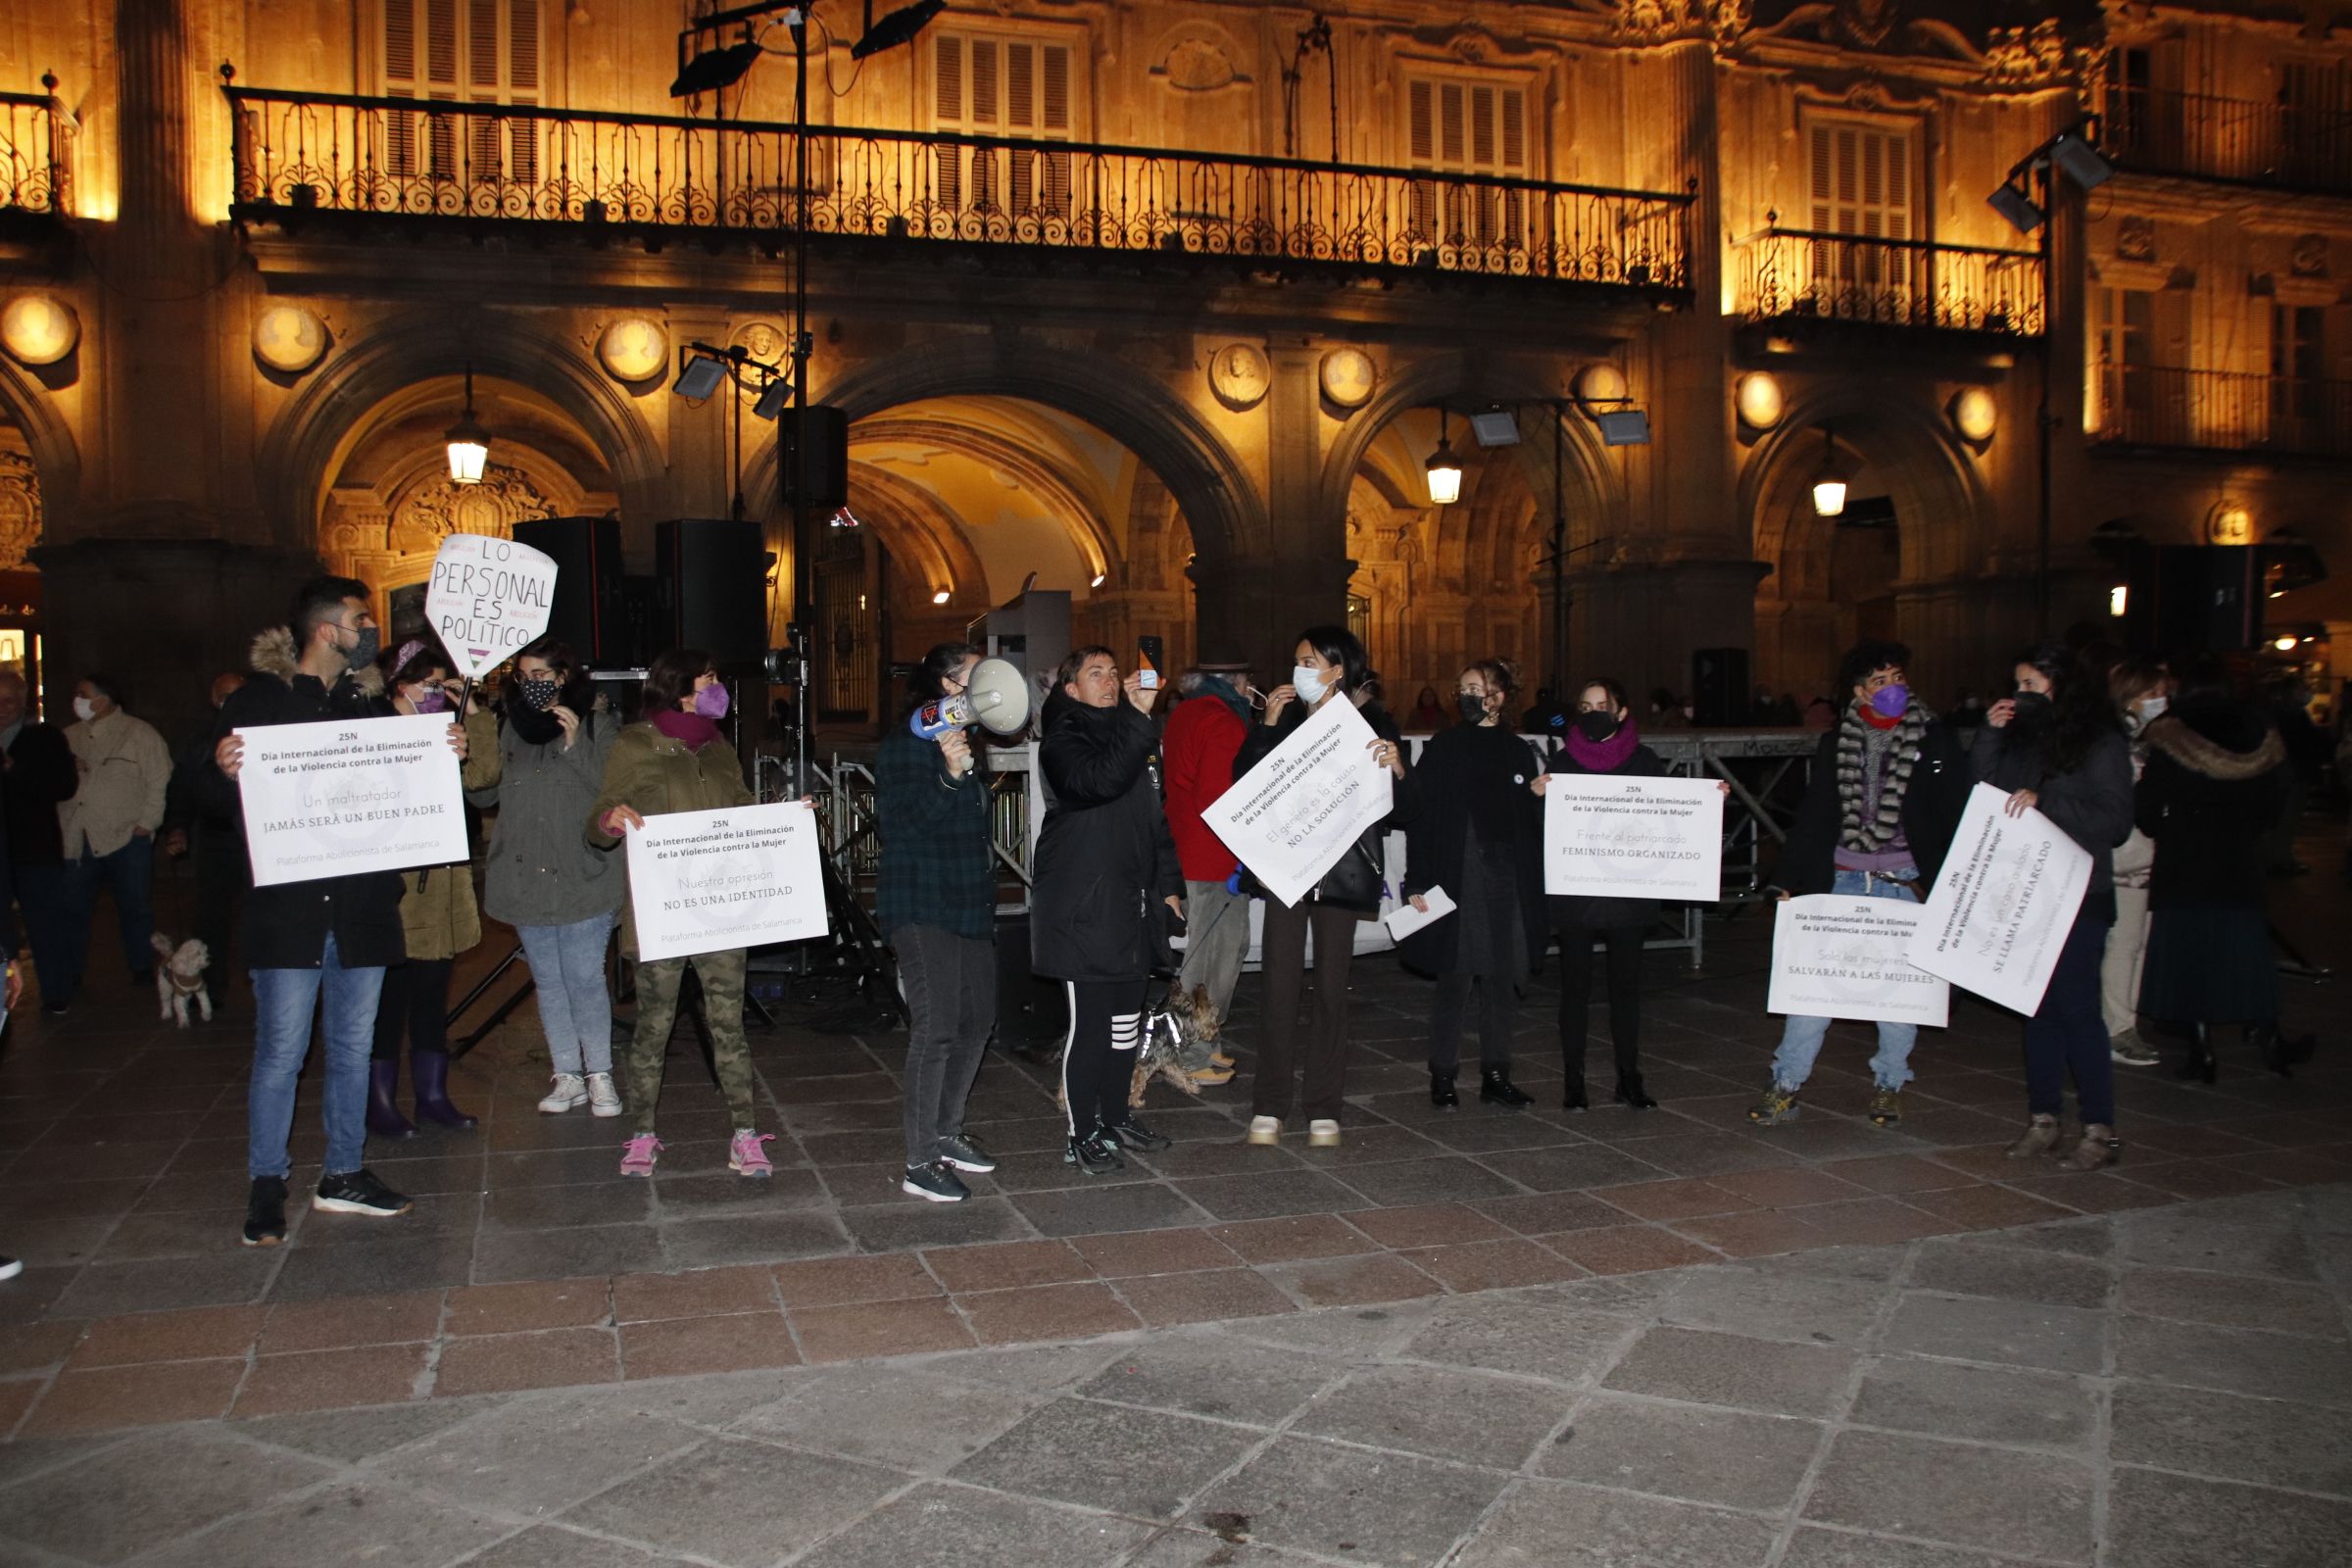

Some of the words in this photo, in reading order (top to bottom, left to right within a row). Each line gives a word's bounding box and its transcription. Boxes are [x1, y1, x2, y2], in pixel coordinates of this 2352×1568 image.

[482, 540, 511, 562] LO
[433, 561, 549, 608] PERSONAL
[473, 598, 503, 620] ES
[441, 614, 529, 647] POLÍTICO
[281, 746, 349, 760] Internacional
[377, 740, 431, 751] Eliminación
[301, 760, 346, 771] Violencia
[349, 759, 381, 767] contra
[395, 754, 422, 763] Mujer
[1243, 771, 1286, 811] Internacional
[1286, 764, 1295, 773] de
[1301, 724, 1341, 759] Eliminación
[1271, 758, 1285, 771] 25N
[1246, 816, 1254, 825] de
[1260, 783, 1291, 810] Violencia
[1292, 763, 1313, 784] contra
[1320, 738, 1340, 758] Mujer
[303, 795, 322, 809] Un
[326, 787, 402, 807] maltratador
[264, 818, 305, 833] JAMÁS
[309, 813, 340, 827] SERÁ
[345, 812, 363, 823] UN
[368, 808, 400, 820] BUEN
[405, 805, 444, 816] PADRE
[1287, 835, 1301, 848] NO
[1301, 824, 1315, 835] LA
[1314, 781, 1359, 824] SOLUCIÓN
[663, 833, 721, 846] Internacional
[746, 826, 794, 837] Eliminación
[680, 846, 720, 857] Violencia
[761, 839, 786, 848] Mujer
[1563, 848, 1624, 857] FEMINISMO
[1628, 850, 1700, 859] ORGANIZADO
[678, 874, 724, 891] Nuestra
[727, 870, 774, 888] opresión
[1949, 872, 1960, 888] 25N
[664, 901, 680, 910] NO
[684, 899, 697, 907] ES
[701, 895, 725, 906] UNA
[729, 886, 792, 902] IDENTIDAD
[1994, 961, 2004, 972] SE
[1999, 923, 2020, 957] LLAMA
[2015, 841, 2050, 918] PATRIARCADO
[1788, 966, 1846, 977] SALVARÁN
[1885, 973, 1936, 984] MUJERES
